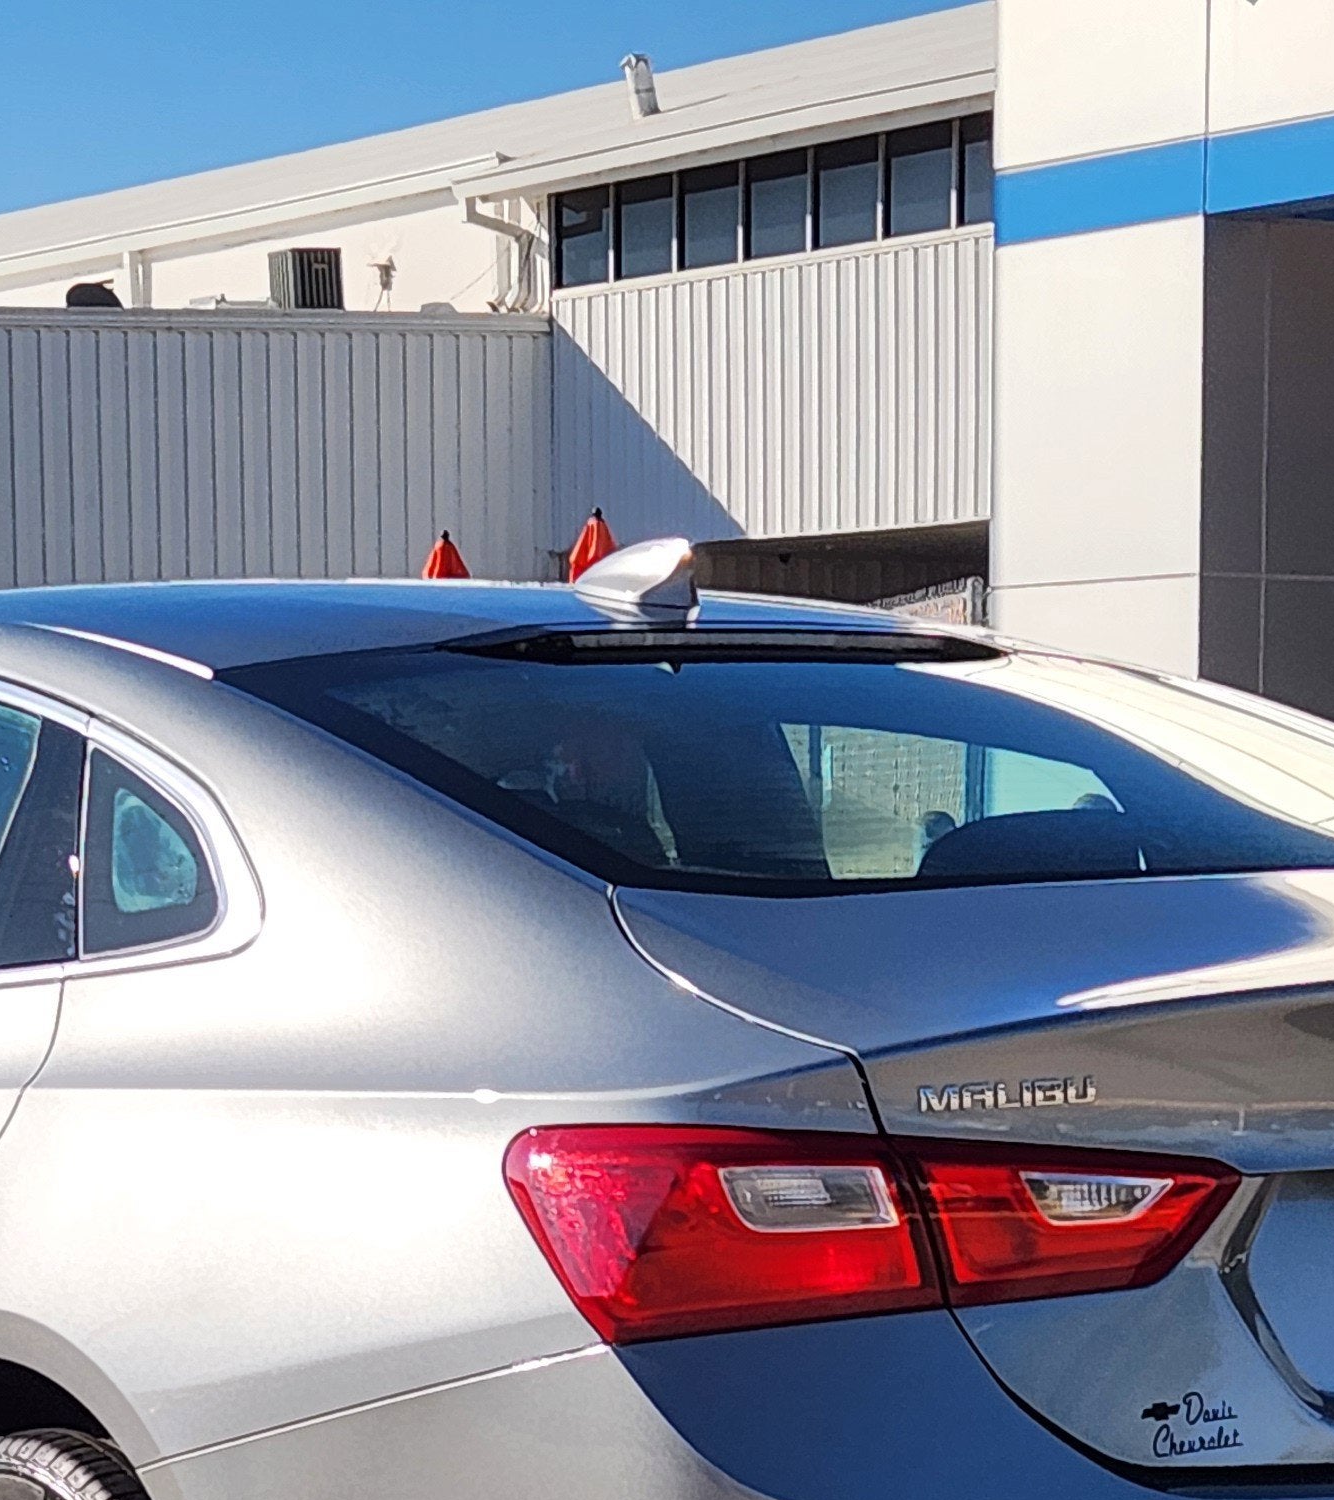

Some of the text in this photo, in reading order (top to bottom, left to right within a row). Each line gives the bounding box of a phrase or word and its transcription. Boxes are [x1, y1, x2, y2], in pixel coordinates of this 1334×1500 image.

[919, 1076, 1097, 1113] MALIBU
[1182, 1391, 1238, 1426] Davis
[1152, 1423, 1244, 1458] Chevrolet
